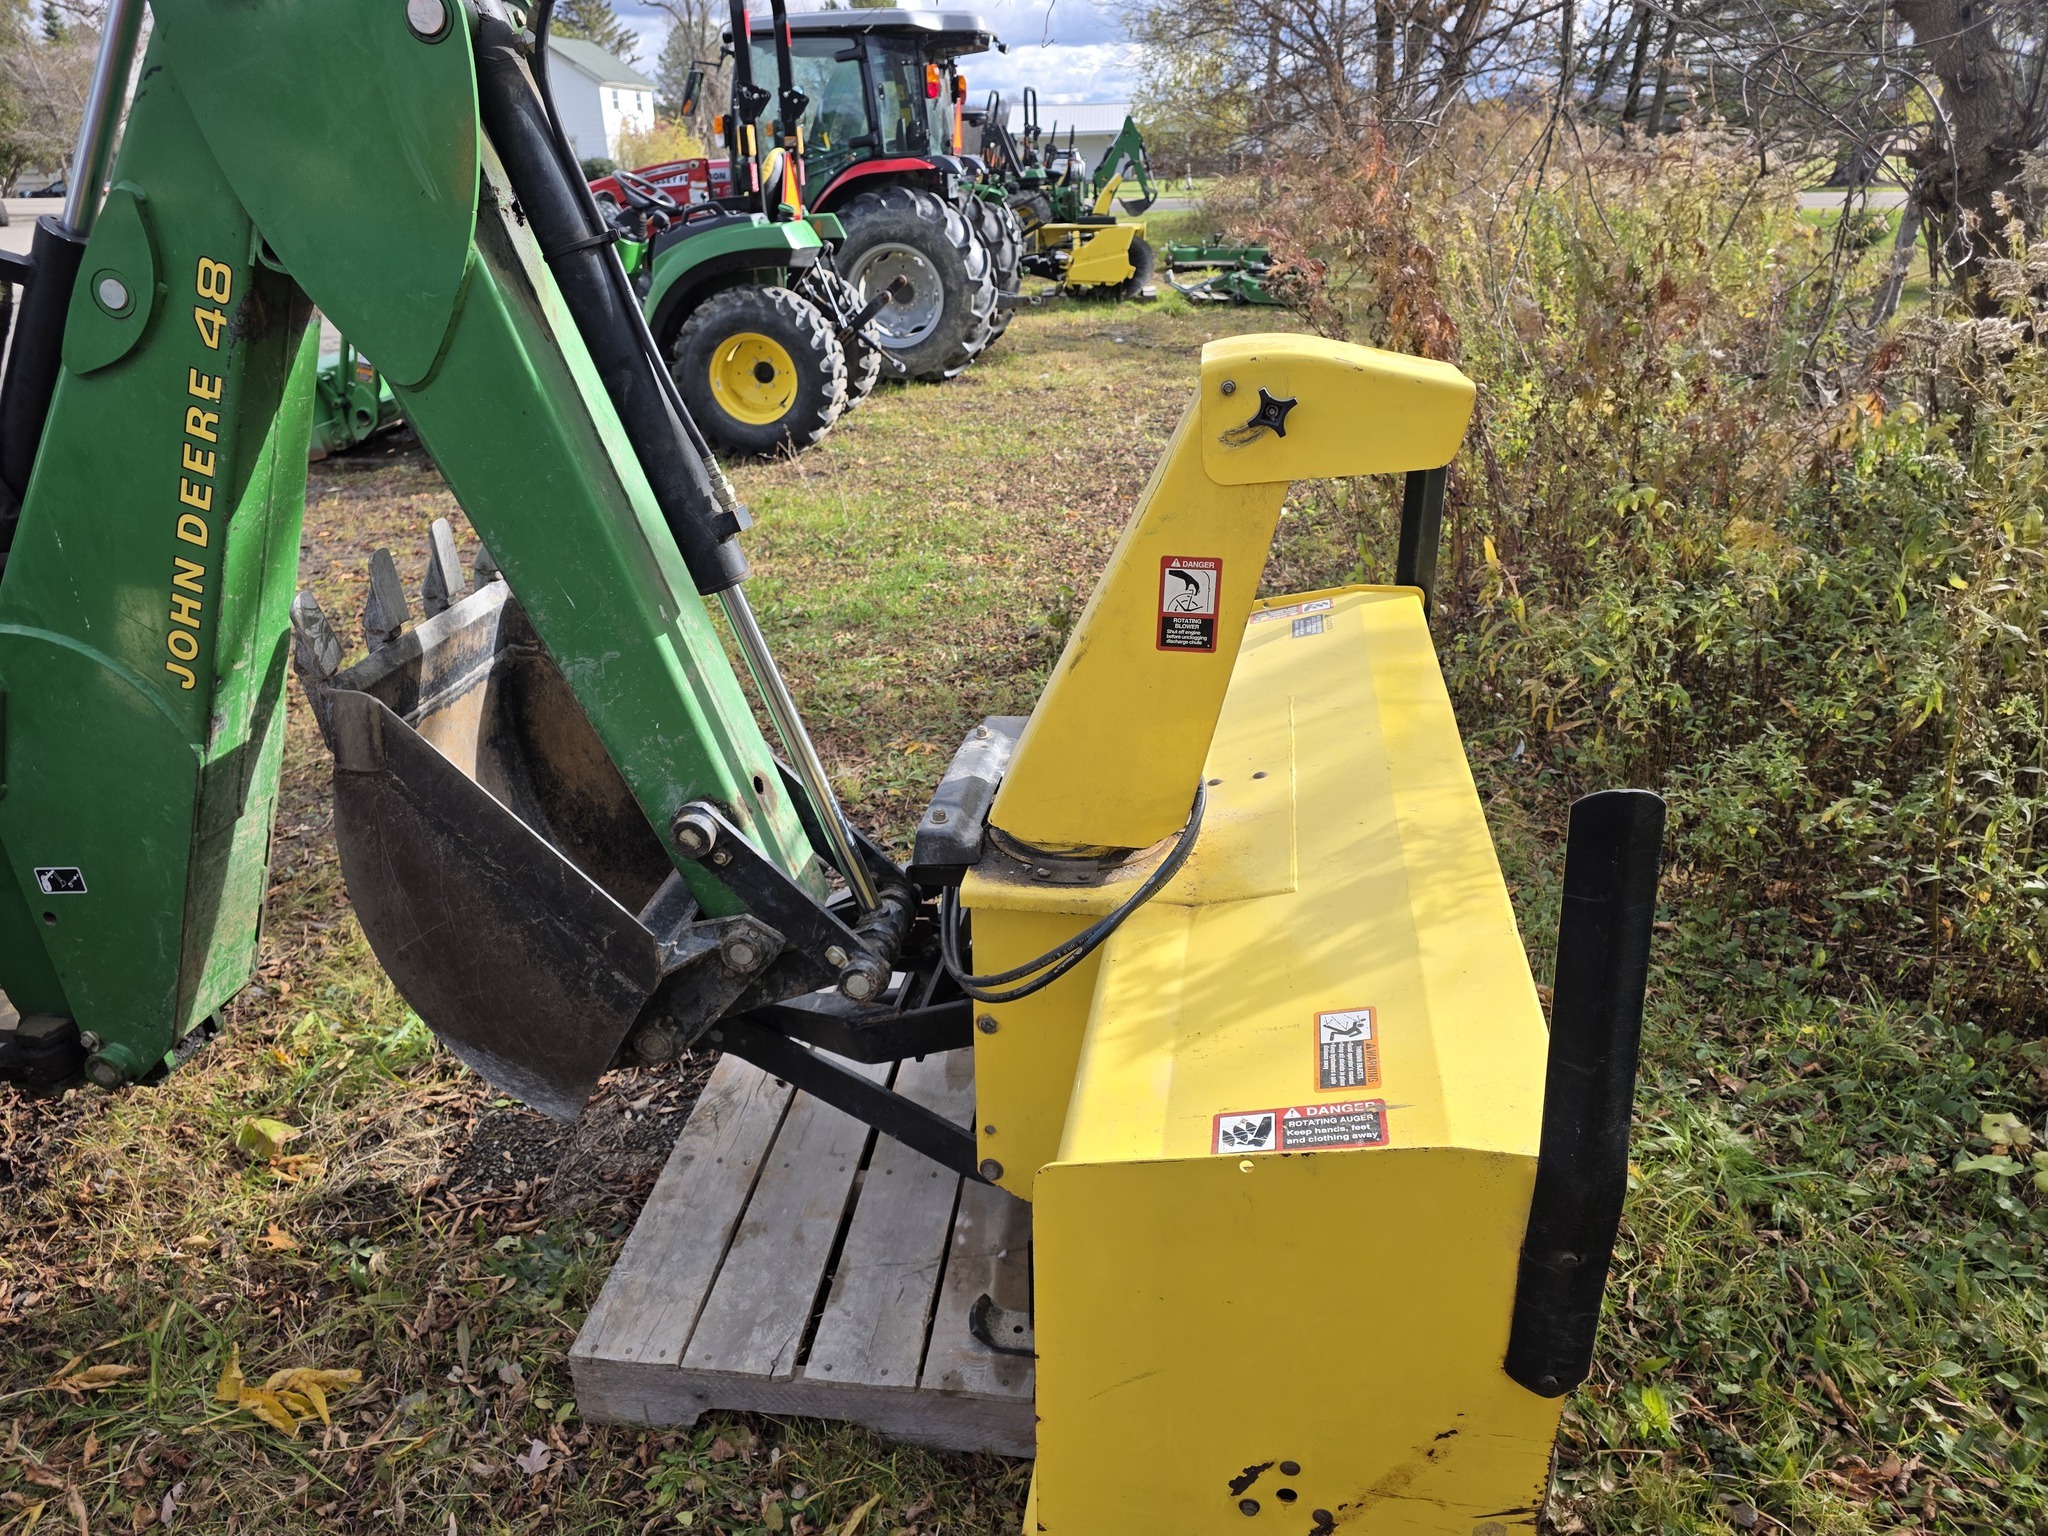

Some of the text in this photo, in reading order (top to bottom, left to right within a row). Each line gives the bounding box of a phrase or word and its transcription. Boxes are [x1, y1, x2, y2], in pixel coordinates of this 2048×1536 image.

[165, 255, 233, 690] JOHN DEERE 48
[1366, 1049, 1378, 1082] WARNING
[1306, 1101, 1376, 1116] DANGER
[1288, 1114, 1374, 1127] ROTATING AUGER
[1286, 1128, 1312, 1137] Keep
[1314, 1126, 1348, 1134] hands,
[1308, 1133, 1350, 1143] clothing
[1352, 1131, 1378, 1140] away
